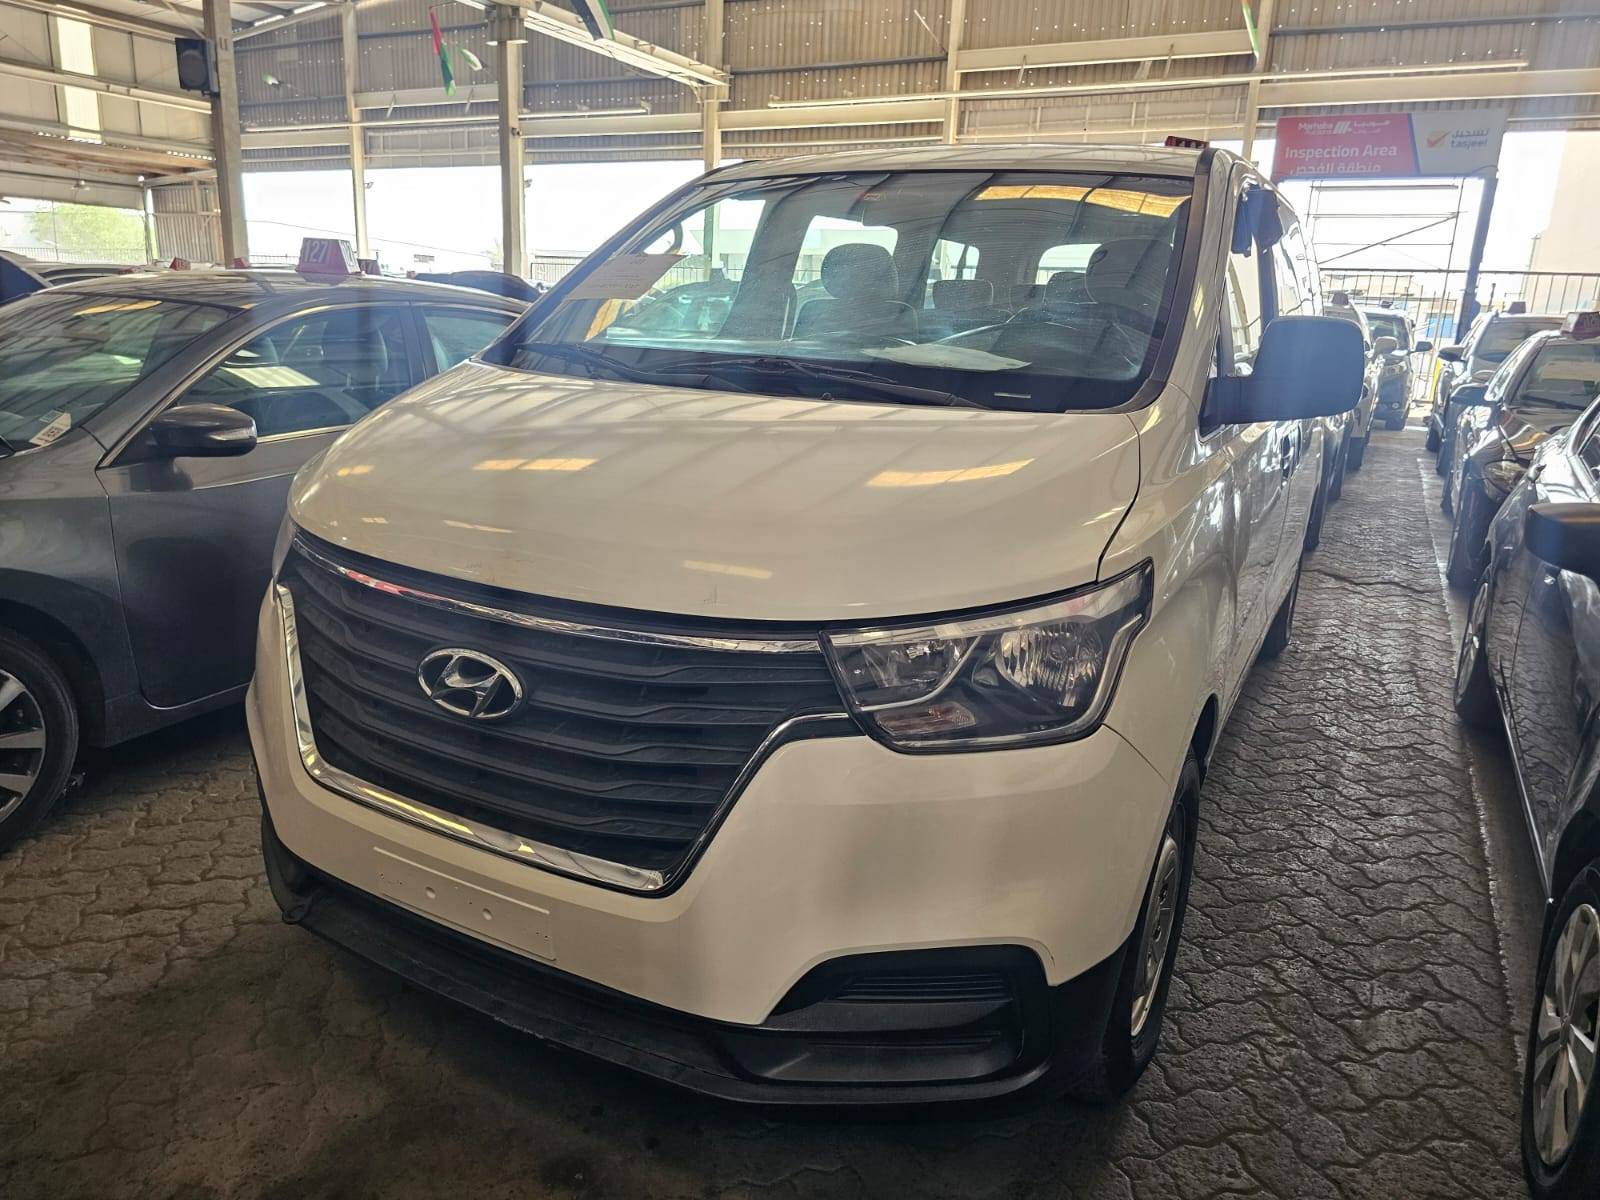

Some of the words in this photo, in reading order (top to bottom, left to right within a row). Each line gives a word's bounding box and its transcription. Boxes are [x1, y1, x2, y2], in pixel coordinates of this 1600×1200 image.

[1285, 145, 1359, 161] Inspection
[1362, 144, 1397, 157] Area
[303, 240, 328, 263] 127
